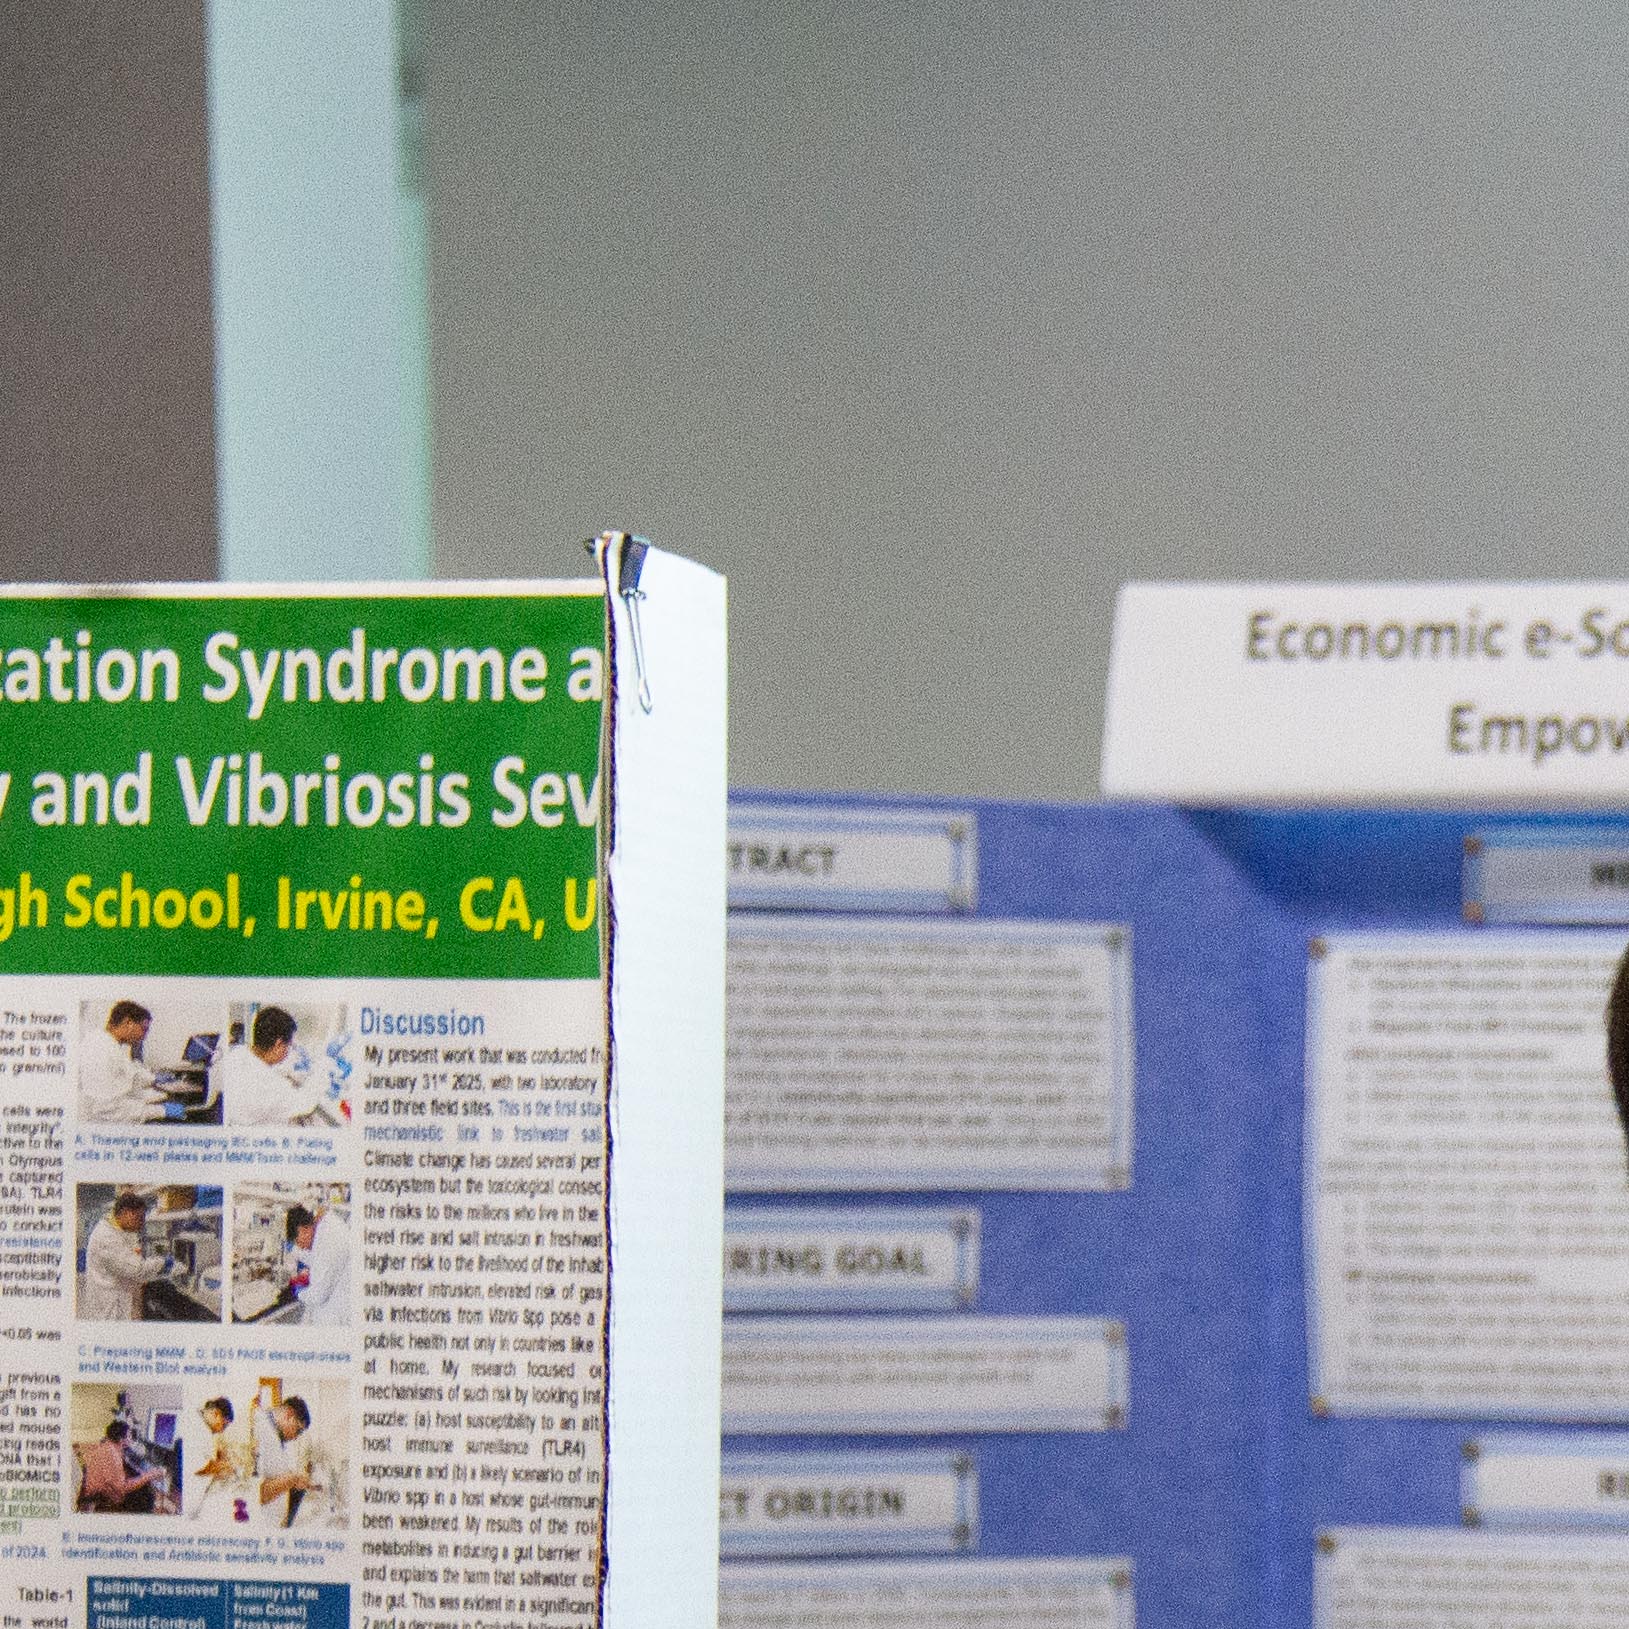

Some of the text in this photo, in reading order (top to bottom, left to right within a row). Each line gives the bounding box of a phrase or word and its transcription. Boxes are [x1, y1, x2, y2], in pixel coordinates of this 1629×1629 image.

[1245, 609, 1508, 663] Economic
[0, 629, 181, 703] ation
[202, 627, 549, 722] Syndrome
[31, 750, 153, 826] and
[175, 751, 472, 828] Vibriosis
[64, 871, 256, 938] School,
[277, 873, 439, 939] Irvine,
[459, 876, 545, 941] CA,
[361, 1007, 485, 1036] Discussion
